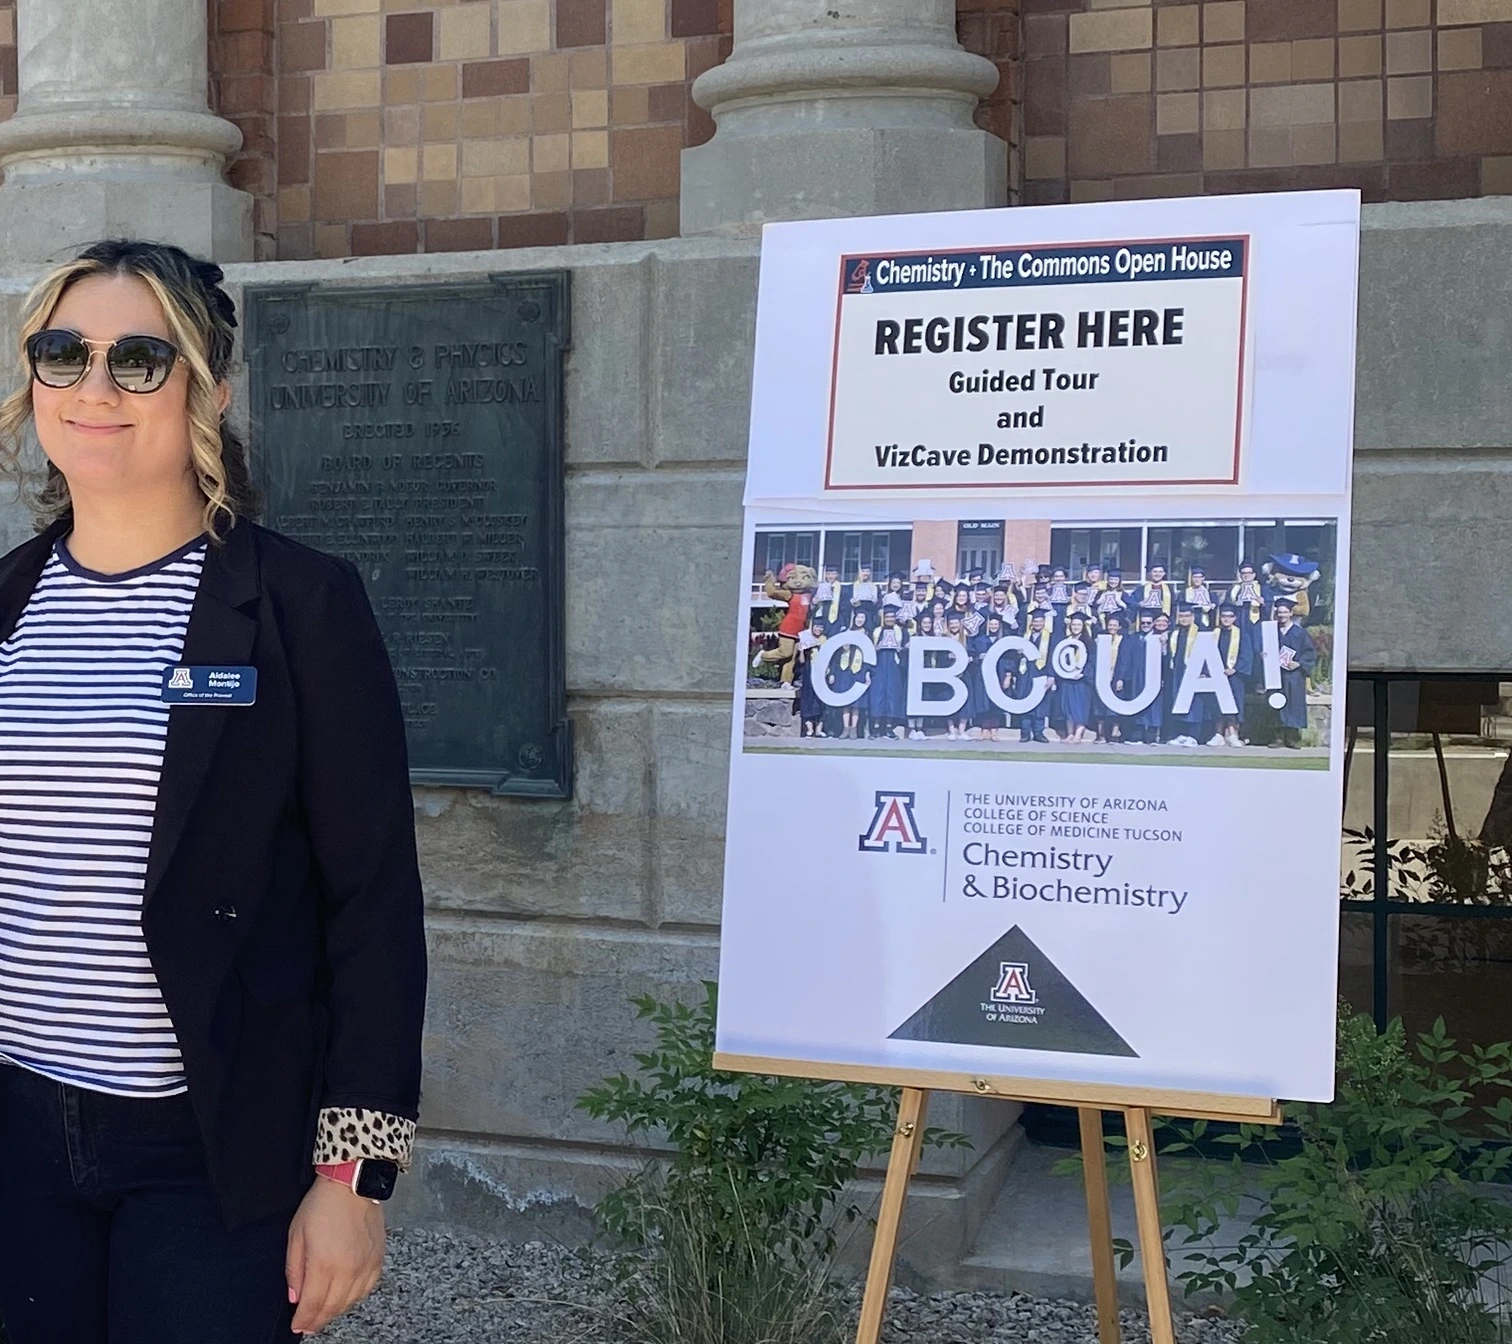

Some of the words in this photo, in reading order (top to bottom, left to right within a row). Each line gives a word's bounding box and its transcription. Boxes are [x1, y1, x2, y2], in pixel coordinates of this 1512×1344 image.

[875, 256, 966, 288] Chemistry
[979, 254, 1014, 280] The
[1017, 251, 1110, 278] Commons
[1115, 249, 1166, 275] Open
[1171, 245, 1232, 271] House
[875, 312, 1066, 356] REGISTER
[1077, 307, 1186, 349] HERE
[282, 346, 399, 374] CHEMISTRY
[434, 342, 528, 369] PHYSICS
[270, 381, 393, 410] UNIVERSITY
[403, 379, 434, 406] OF
[445, 375, 539, 405] ARIZONA
[948, 369, 1036, 394] Guided
[1042, 367, 1100, 392] Tour
[996, 404, 1045, 430] and
[875, 442, 972, 469] VizCave
[976, 440, 1169, 467] Demonstration
[964, 792, 991, 806] THE
[995, 794, 1076, 809] UNIVERSITY
[1080, 797, 1099, 809] OF
[1103, 798, 1169, 812] ARIZONA
[964, 807, 1024, 822] COLLEGE
[1027, 810, 1048, 822] OF
[1050, 811, 1109, 824] SCIENCE
[963, 822, 1024, 836] COLLEGE
[1027, 824, 1047, 837] OF
[1050, 825, 1120, 840] MEDICINE
[1124, 828, 1183, 843] TUCSON
[962, 842, 1114, 878] Chemistry
[962, 873, 988, 899] &
[992, 875, 1189, 915] Biochemistry
[980, 1002, 997, 1012] THE
[998, 1003, 1046, 1016] UNIVERSITY
[986, 1013, 998, 1021] OF
[998, 1013, 1038, 1025] ARIZONA
